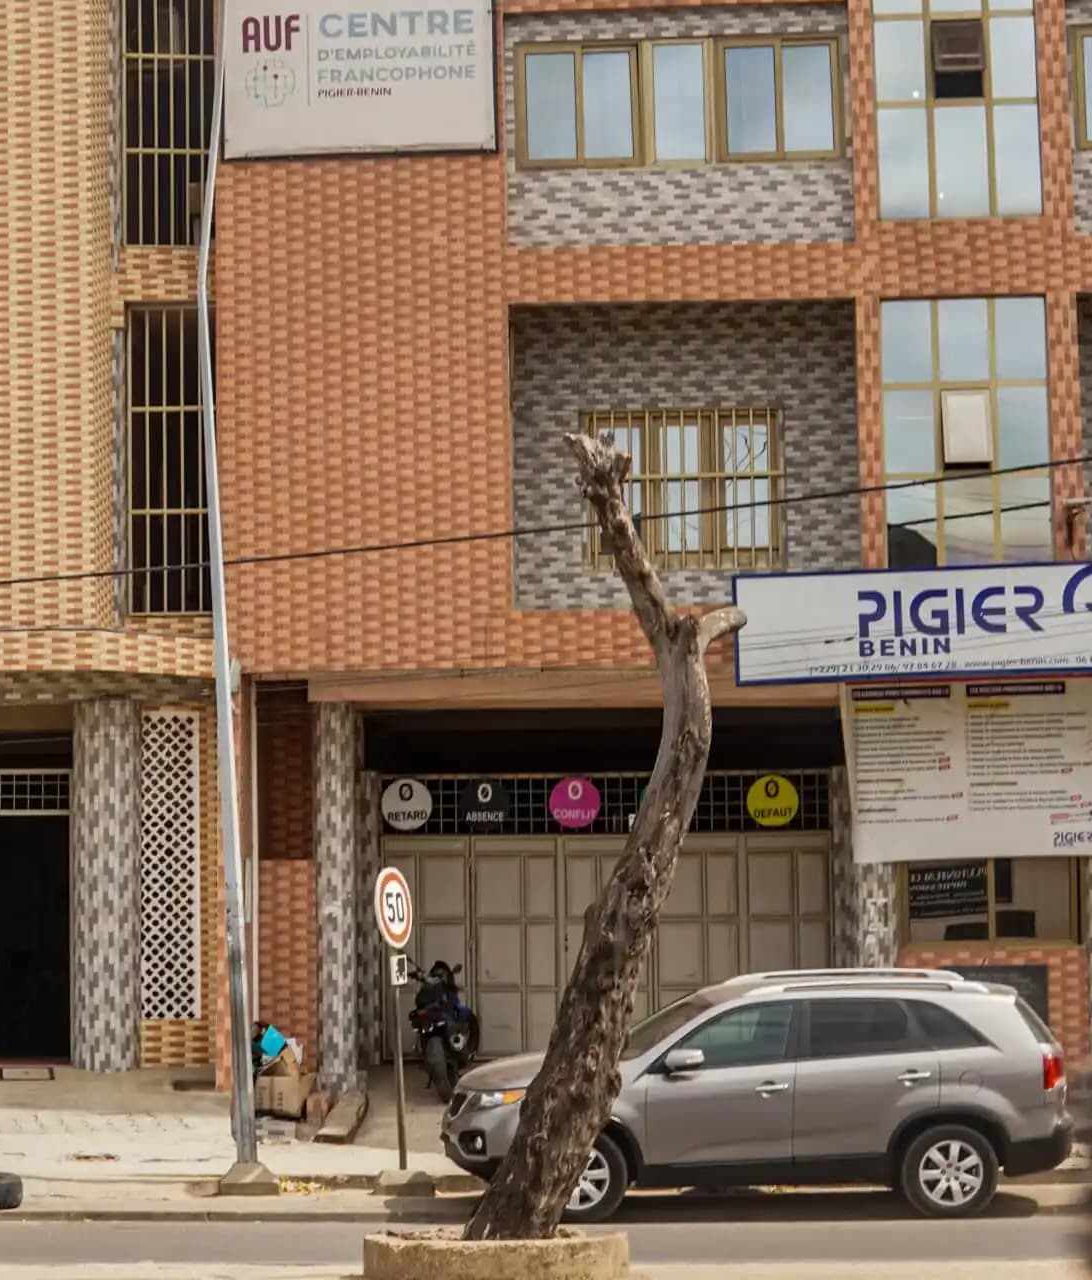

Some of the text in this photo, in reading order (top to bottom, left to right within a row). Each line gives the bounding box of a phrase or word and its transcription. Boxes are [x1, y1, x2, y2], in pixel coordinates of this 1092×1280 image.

[318, 9, 475, 38] CENTRE
[242, 14, 300, 53] AUF
[317, 41, 476, 62] D'EMPLOYABILITÉ
[317, 64, 476, 84] FRANCOPHONE
[318, 87, 392, 98] PIGIER-BENIN
[858, 585, 1045, 638] PIGIER
[858, 637, 951, 657] BENIN
[399, 783, 413, 801] 0
[477, 783, 492, 802] 0
[568, 781, 582, 800] 0
[765, 780, 779, 799] 0
[388, 810, 427, 821] RETARD
[466, 811, 504, 822] ABSENCE
[553, 808, 597, 820] CONFLIT
[385, 892, 405, 923] 50
